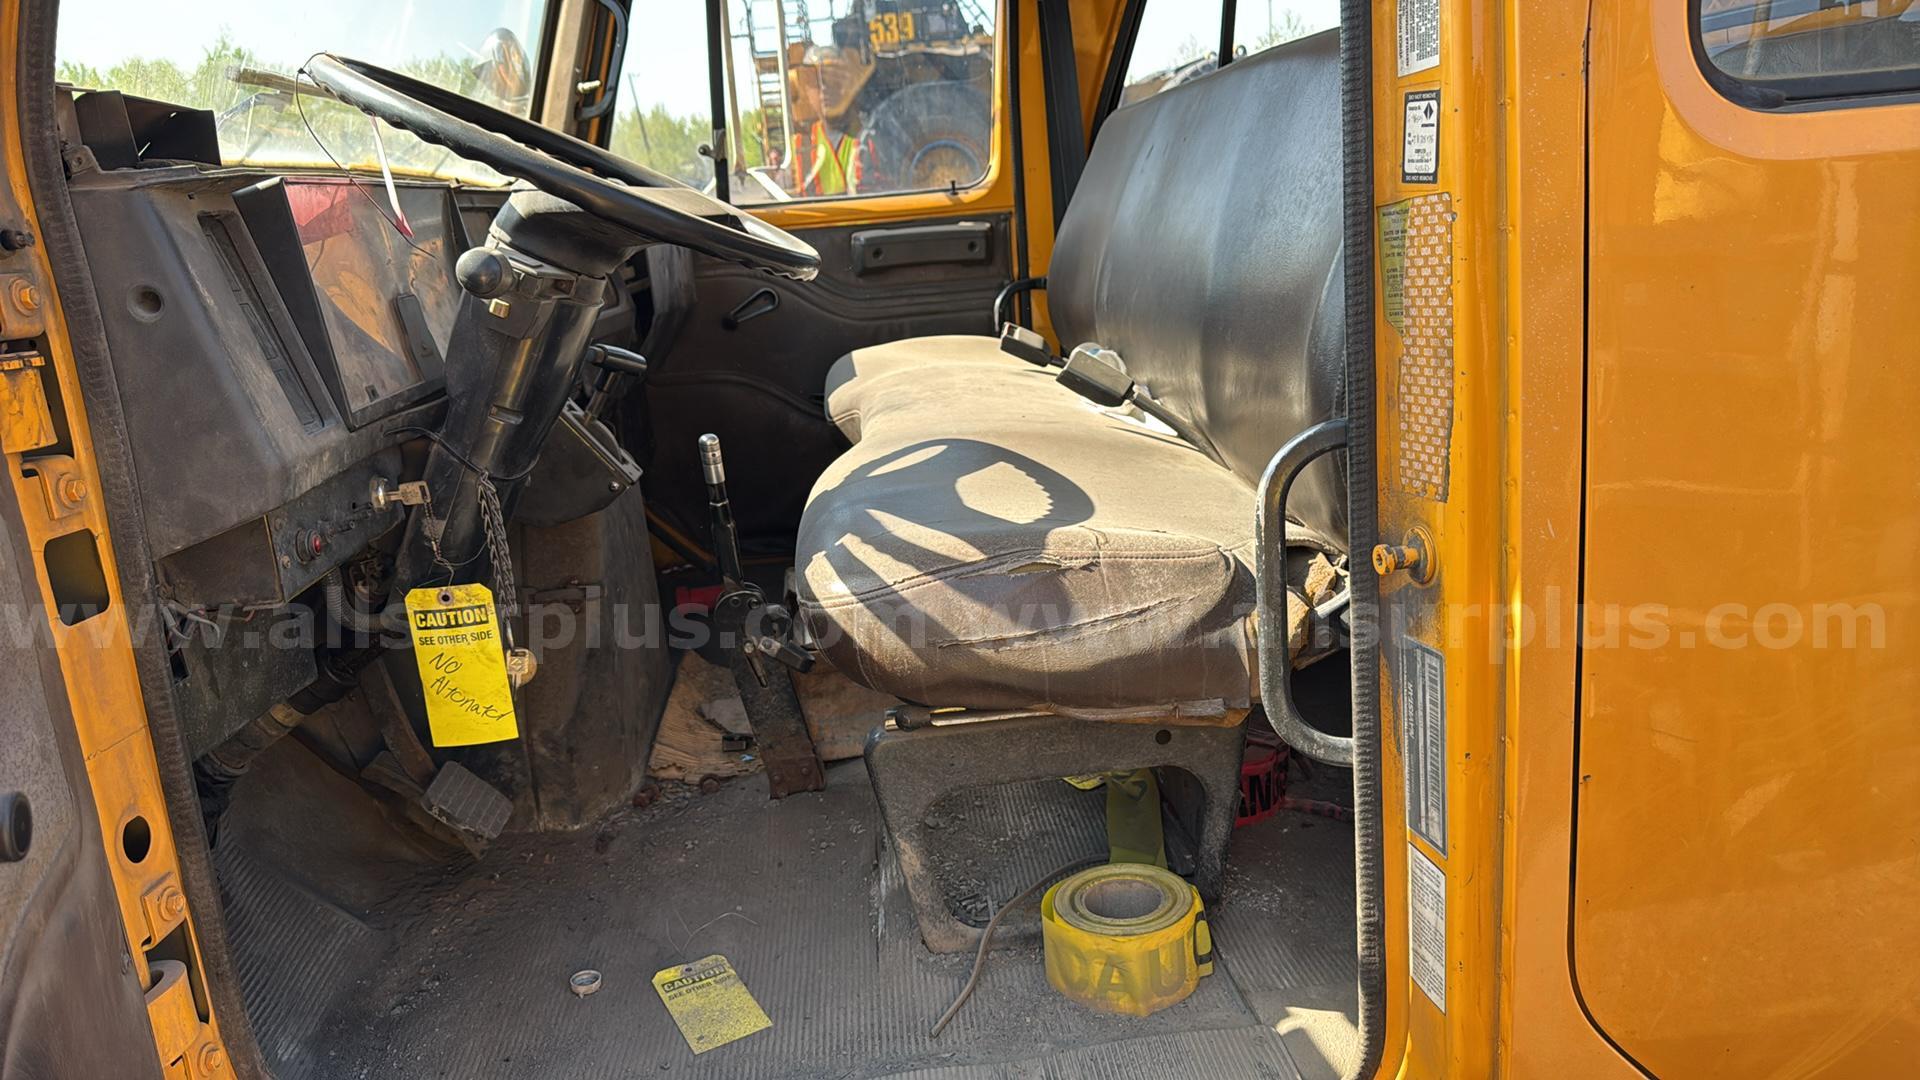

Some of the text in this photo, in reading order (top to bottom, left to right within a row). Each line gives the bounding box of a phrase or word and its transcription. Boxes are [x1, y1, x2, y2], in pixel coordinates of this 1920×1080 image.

[869, 11, 915, 52] 539
[415, 607, 488, 628] CAUTION
[419, 630, 493, 646] SEE OTHER SIDE
[1408, 683, 1418, 740] NAVISTAR
[663, 966, 726, 990] CAUTION
[685, 982, 712, 993] OTHER
